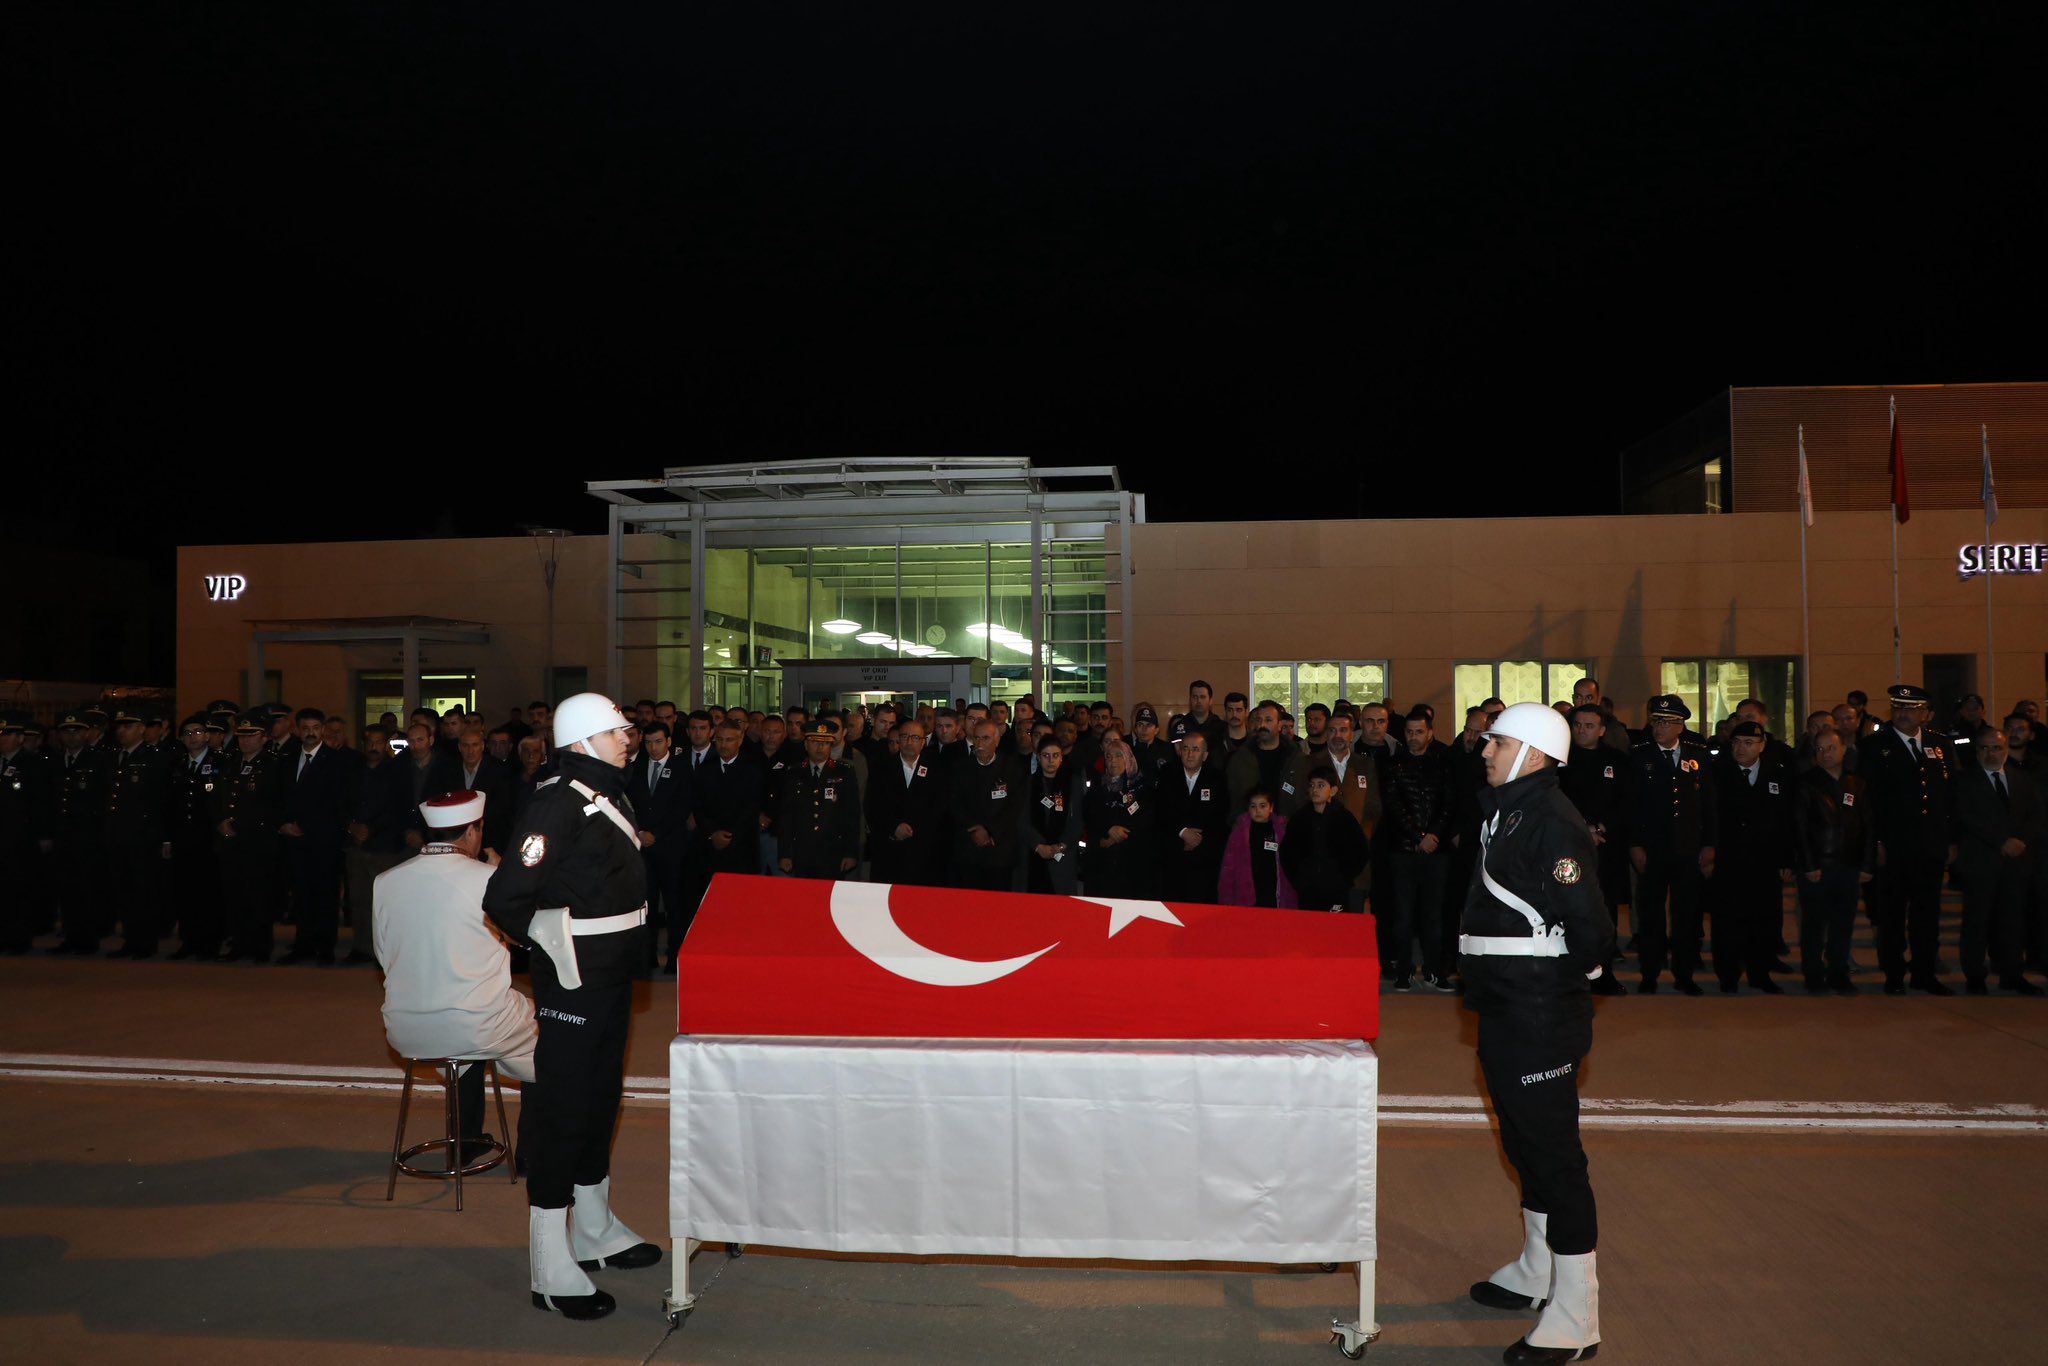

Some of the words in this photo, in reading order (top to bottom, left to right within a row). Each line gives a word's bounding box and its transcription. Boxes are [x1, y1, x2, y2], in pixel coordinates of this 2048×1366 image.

[203, 575, 246, 602] VIP
[558, 1012, 587, 1026] KUVVET
[1545, 1063, 1573, 1080] KUVVET
